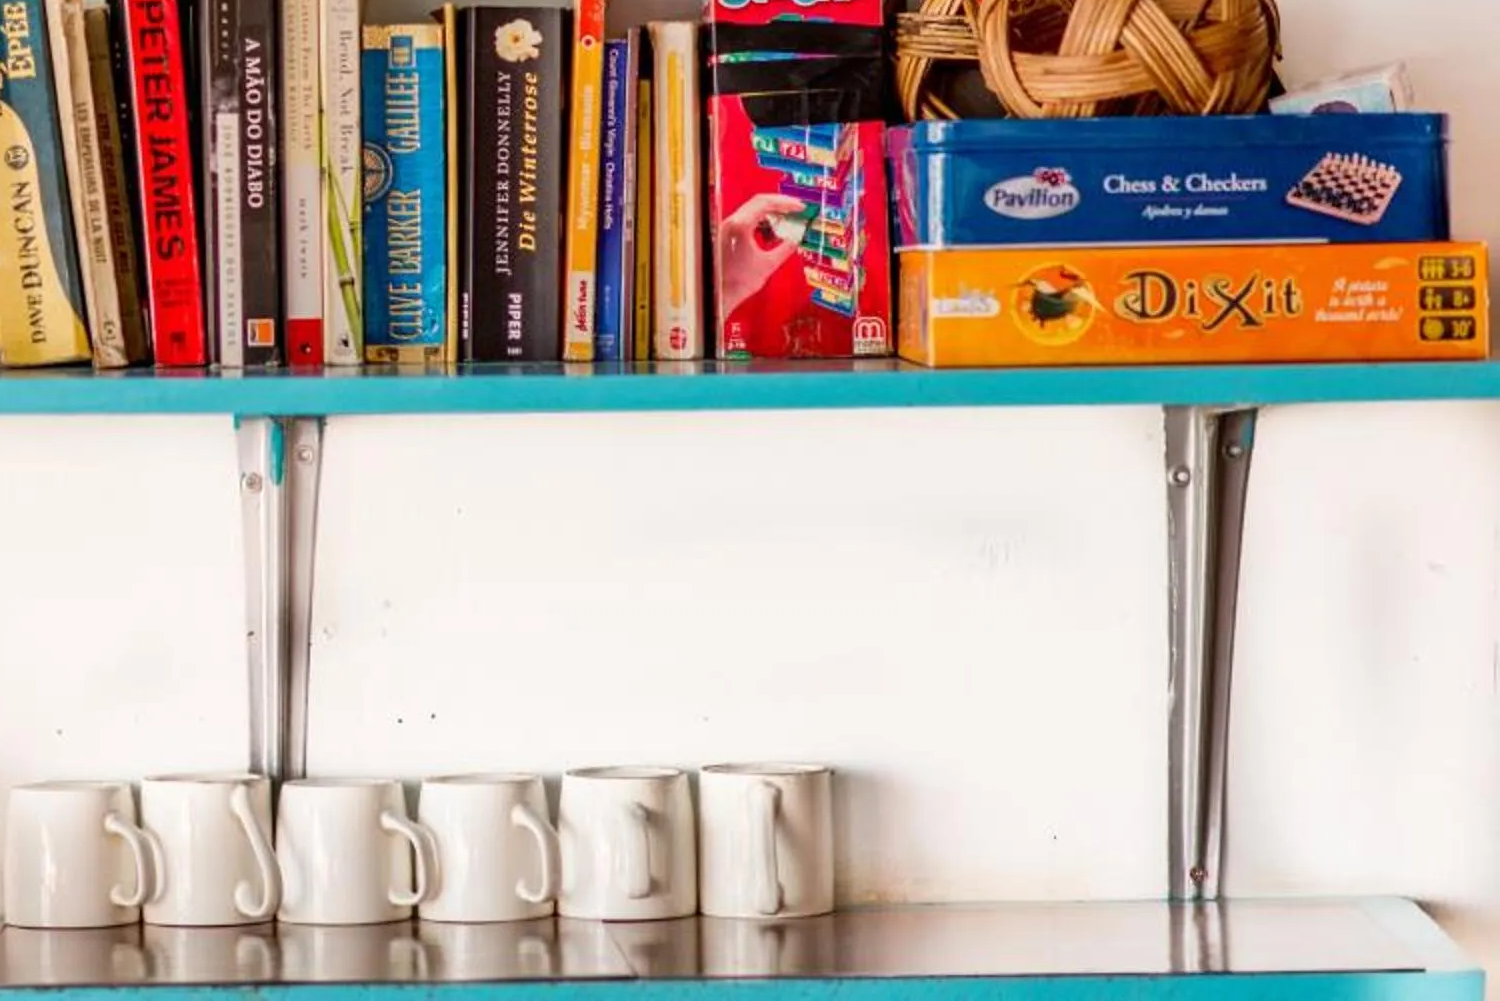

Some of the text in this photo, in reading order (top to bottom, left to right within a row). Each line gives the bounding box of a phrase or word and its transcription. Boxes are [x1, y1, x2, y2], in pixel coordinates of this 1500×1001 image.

[2, 0, 38, 79] ÉPÉE
[244, 37, 265, 209] A MÃO DO DIABO
[338, 123, 355, 177] Break
[386, 71, 421, 155] GALILEE
[518, 70, 539, 252] Die Winterrose
[147, 133, 187, 261] JAMES
[495, 70, 513, 277] JENNIFER DONNELLY
[992, 188, 1075, 209] Pavilion
[1102, 172, 1268, 195] Chess & Checkers
[10, 180, 48, 345] DAVE DUNCAN
[386, 188, 424, 340] CLIVE BARKER
[507, 292, 523, 341] PIPER
